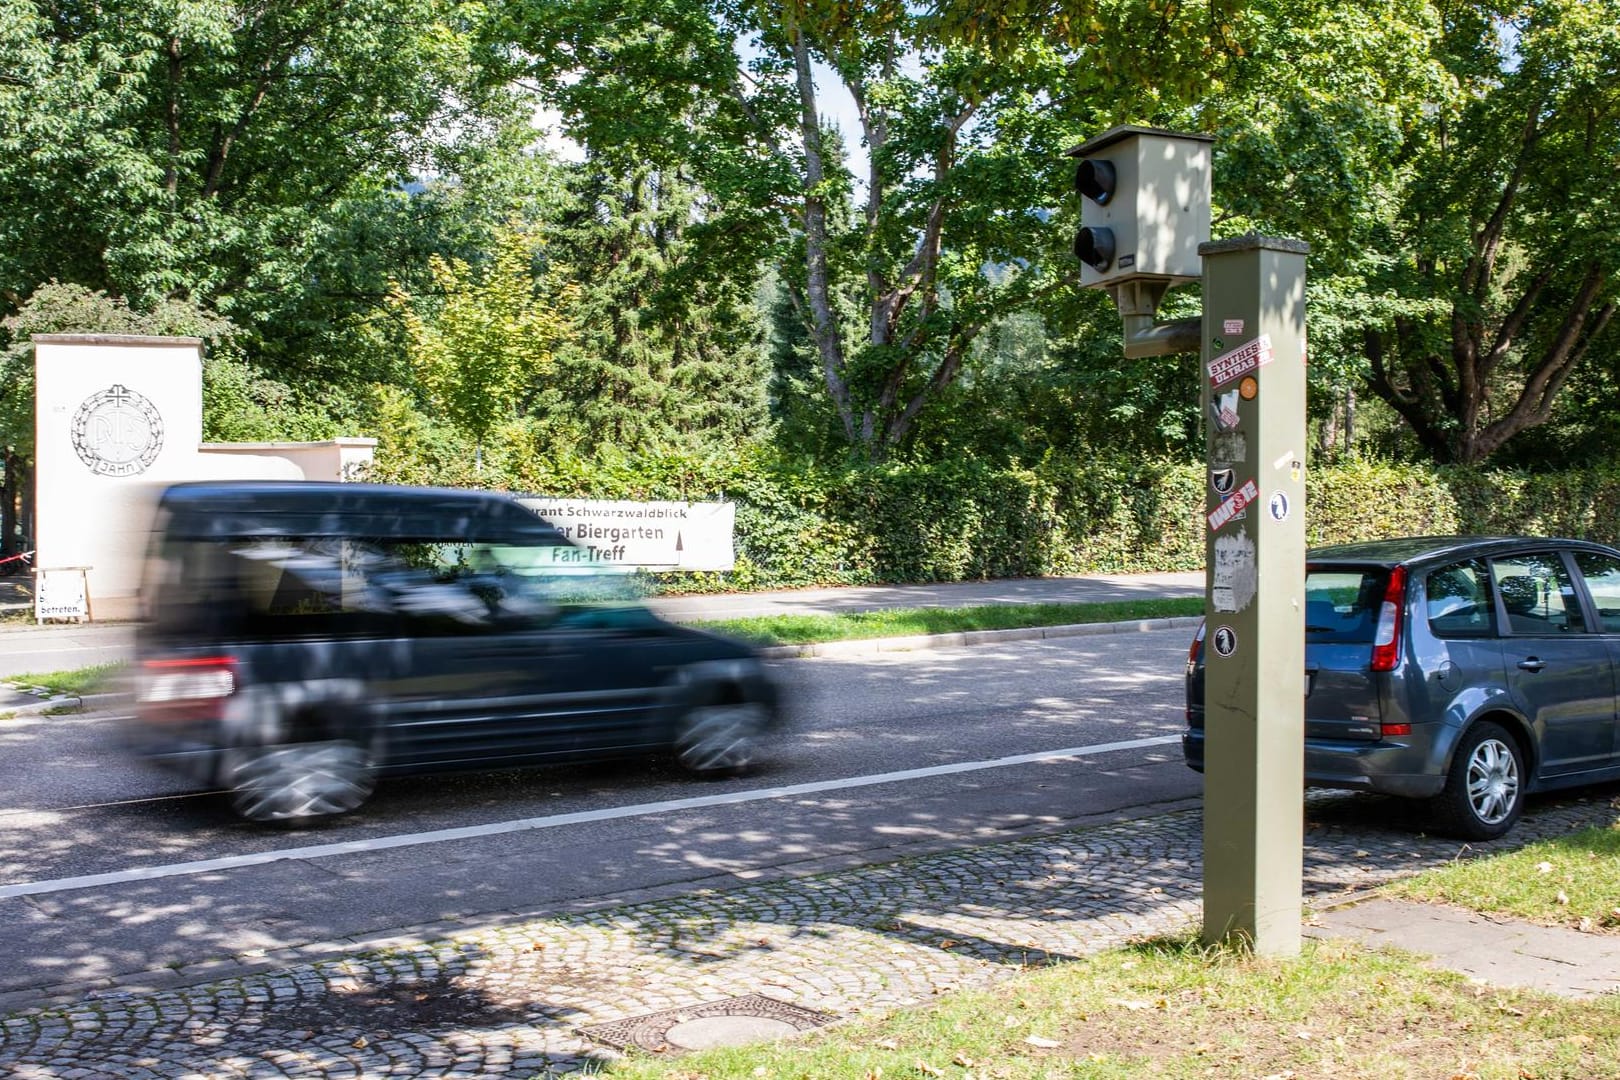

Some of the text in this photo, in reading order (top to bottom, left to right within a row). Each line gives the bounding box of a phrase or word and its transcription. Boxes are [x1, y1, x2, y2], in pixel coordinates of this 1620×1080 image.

[1215, 357, 1255, 383] ULTRAS
[567, 507, 687, 518] Schwarzwaldblick
[577, 523, 664, 542] Biergarten
[552, 545, 625, 563] Fan-Treff
